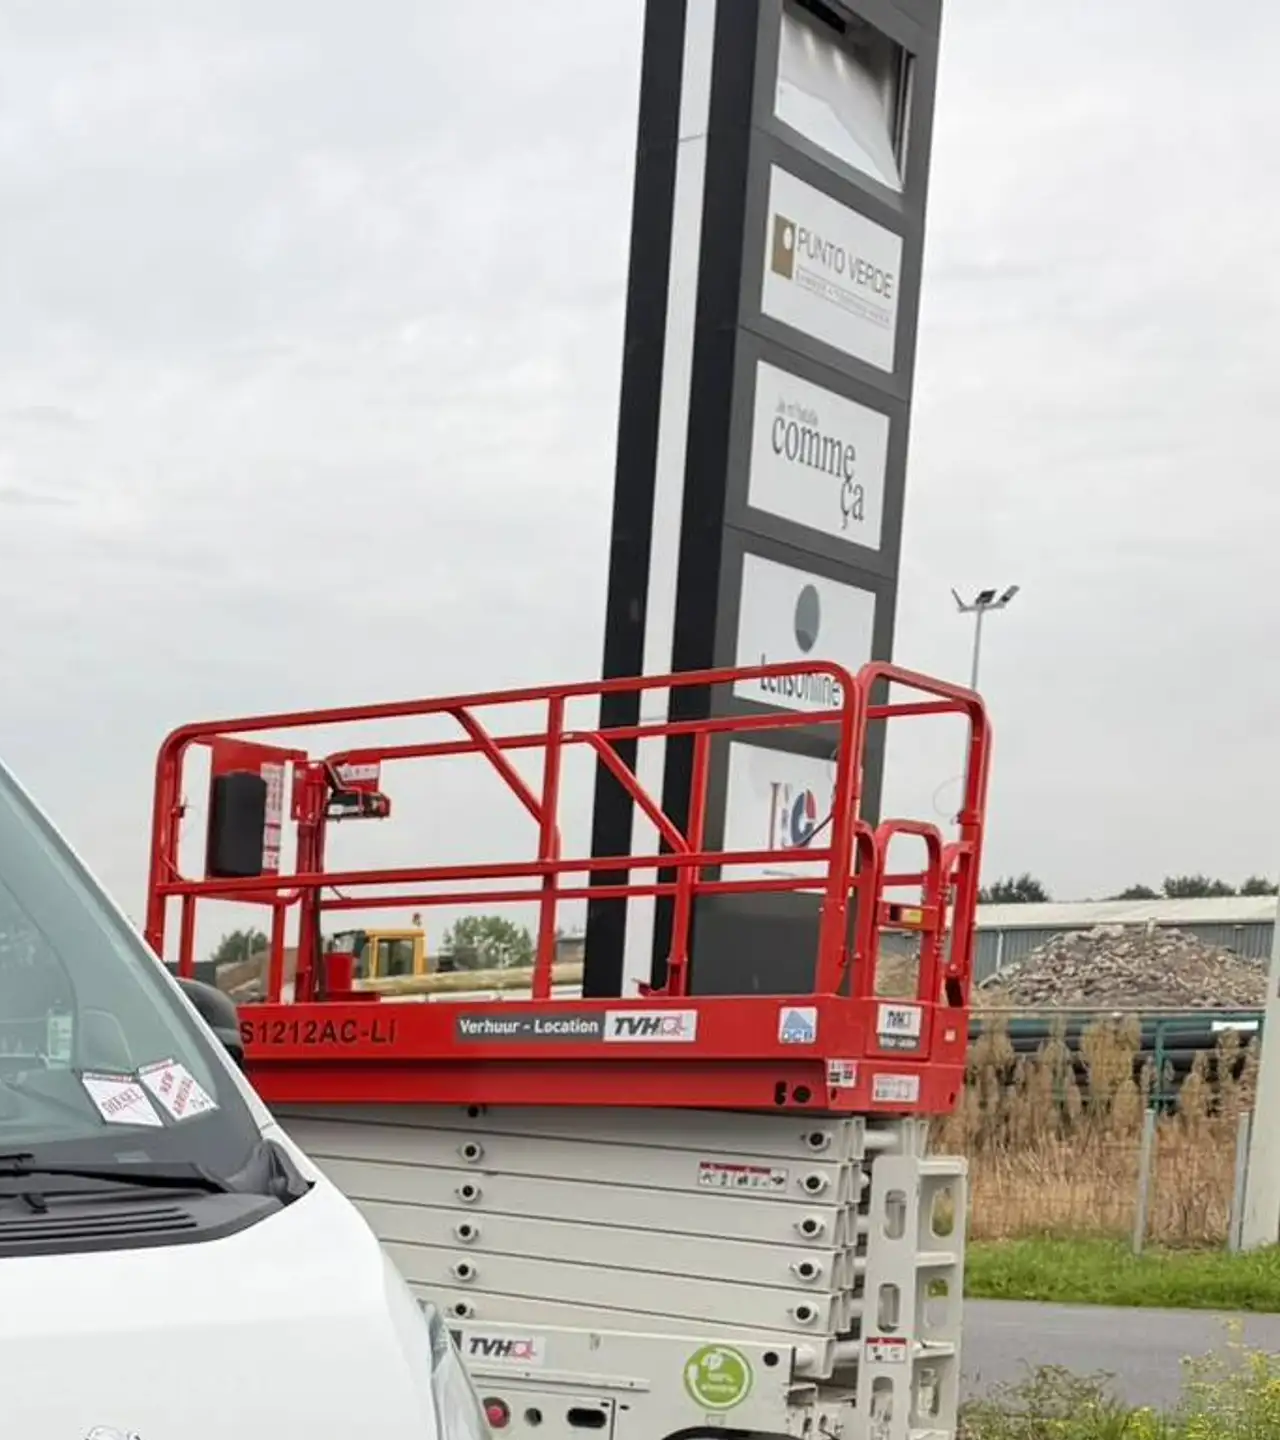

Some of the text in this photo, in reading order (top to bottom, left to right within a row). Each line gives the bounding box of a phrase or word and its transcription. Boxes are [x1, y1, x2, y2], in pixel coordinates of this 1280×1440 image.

[797, 227, 846, 275] PUNTO
[848, 252, 894, 300] VERDE
[772, 416, 856, 482] comme
[840, 480, 864, 530] ça
[459, 1018, 519, 1035] Verhuur
[535, 1017, 599, 1035] Location
[614, 1017, 660, 1036] TVH
[469, 1337, 512, 1357] TVH
